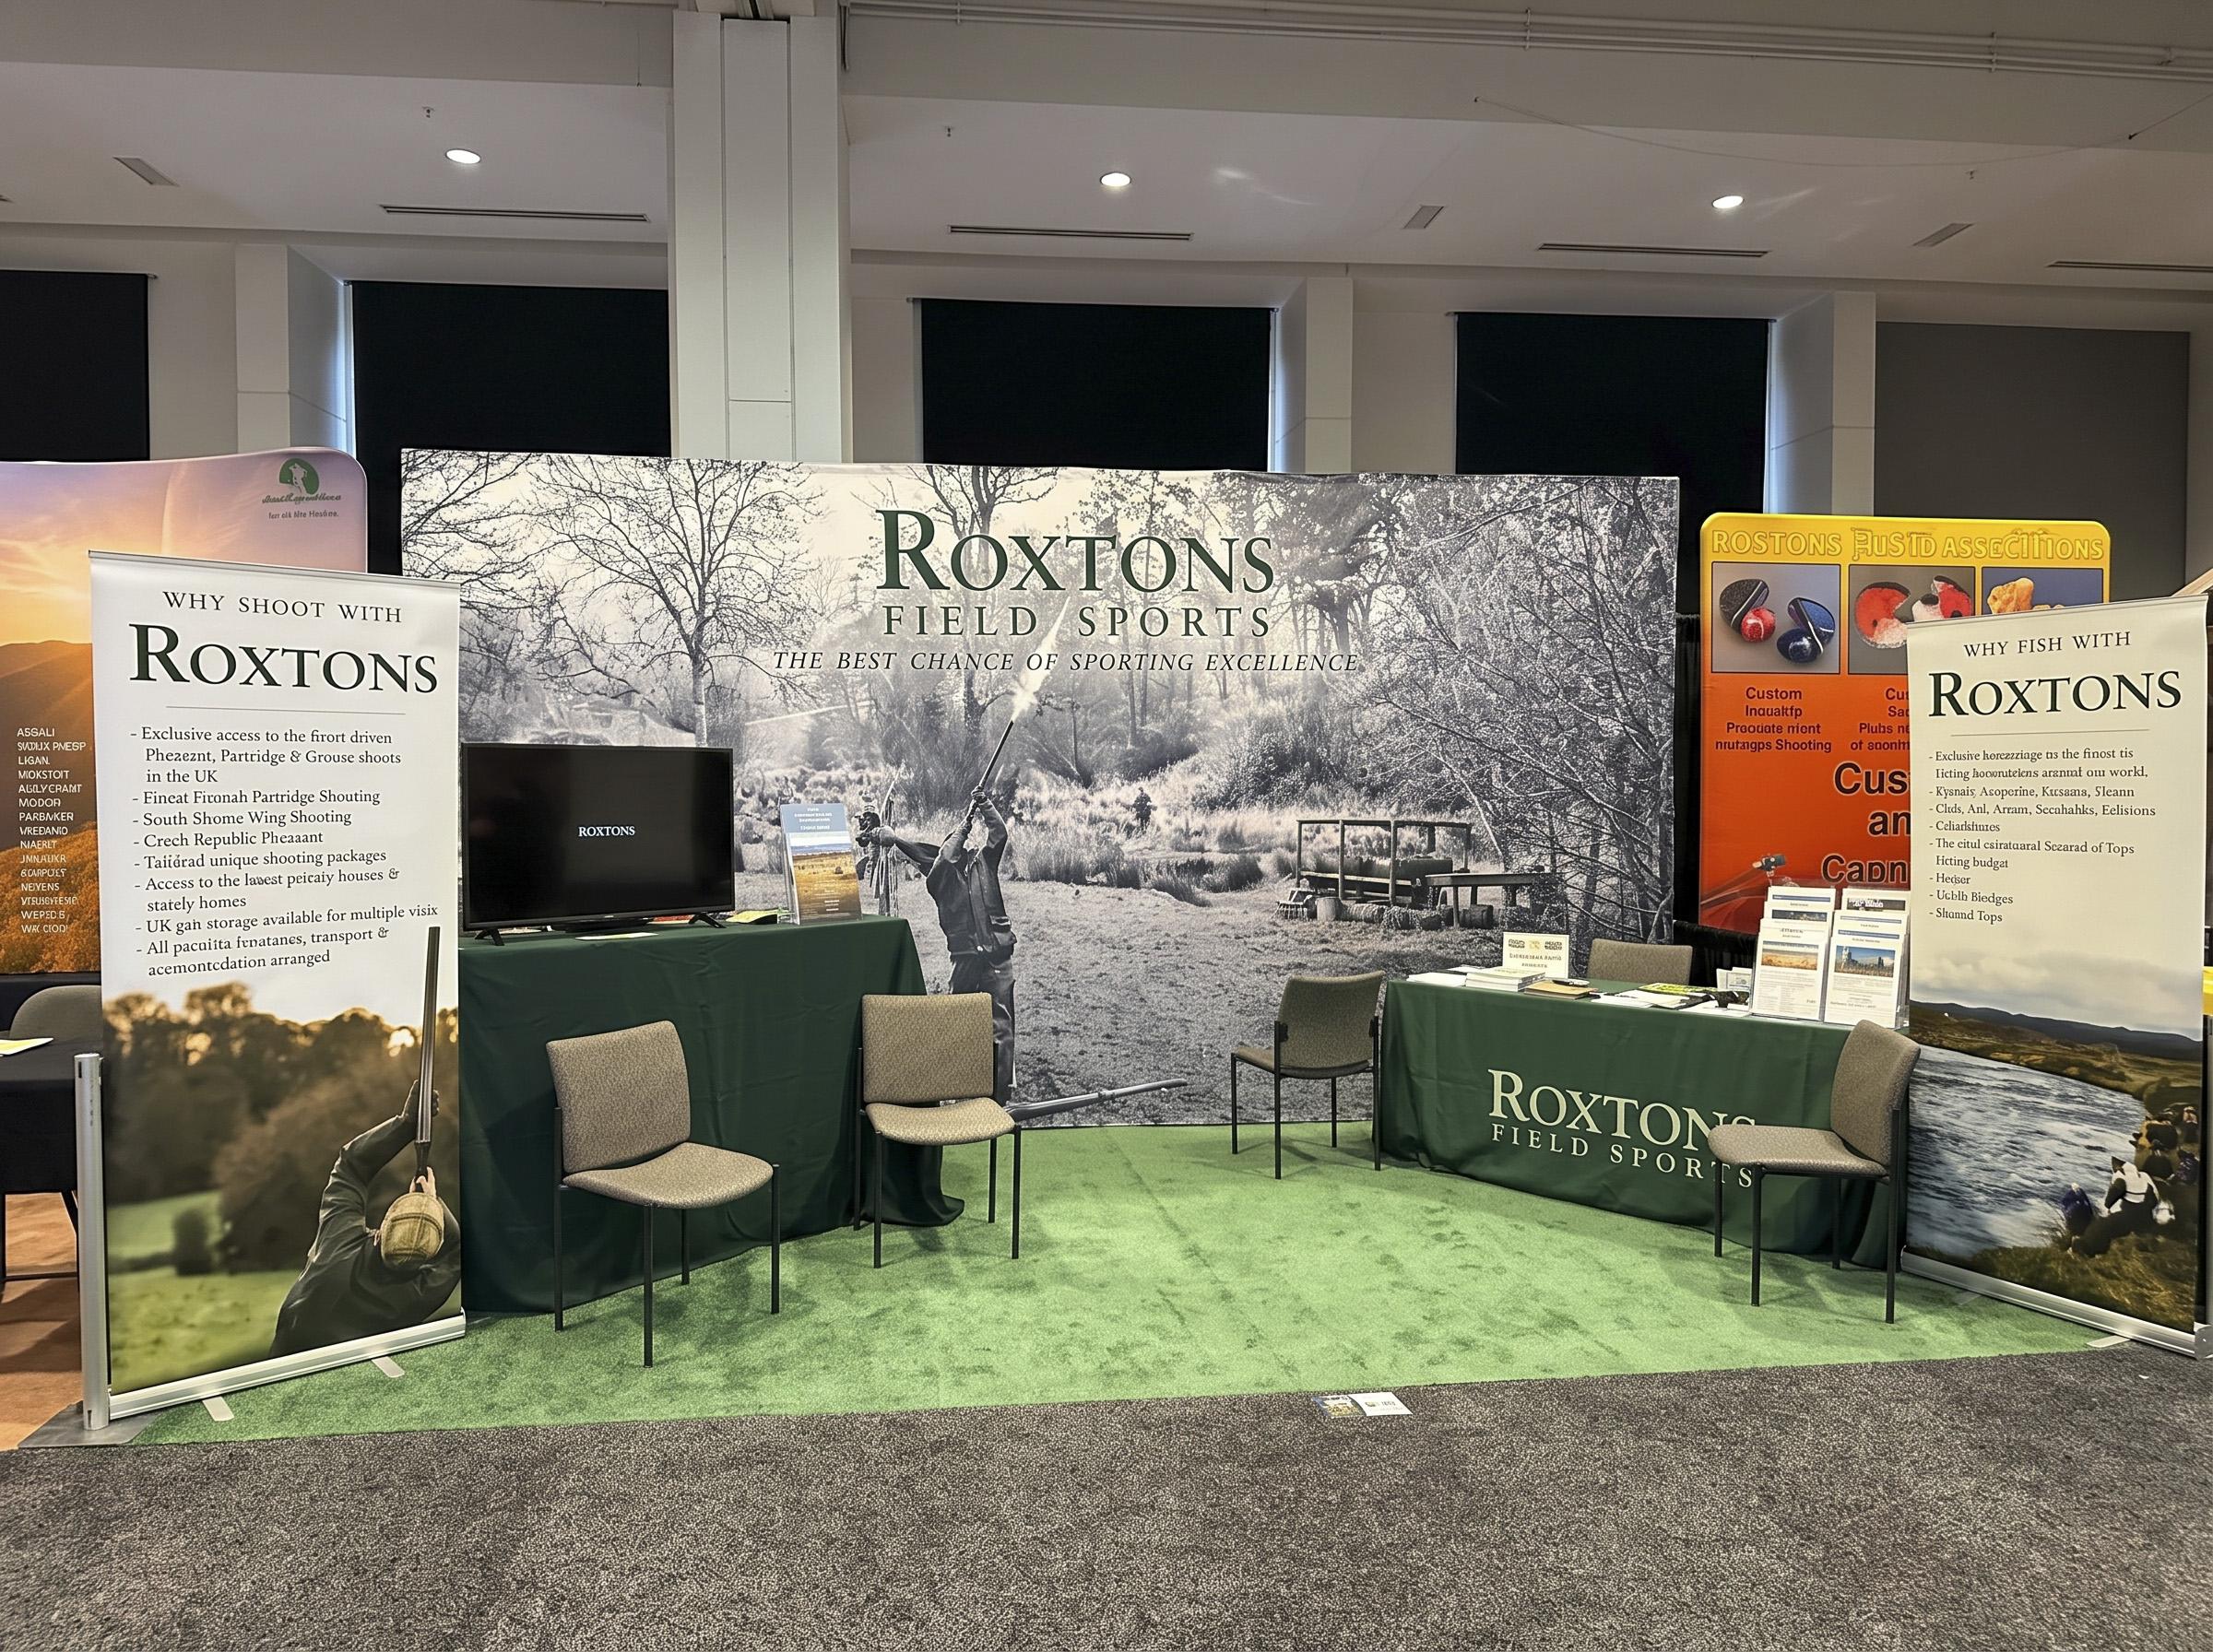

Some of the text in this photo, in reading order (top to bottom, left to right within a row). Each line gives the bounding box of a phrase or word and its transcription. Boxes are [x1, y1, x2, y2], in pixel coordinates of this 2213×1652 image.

[875, 509, 1274, 595] ROXTONS
[1712, 529, 1842, 557] ROSTONS
[161, 590, 402, 623] WHY SHOOT WITH
[882, 606, 1270, 639] FIELD SPORTS
[1964, 631, 2132, 657] WHY FISH WITH
[128, 623, 438, 693] ROXTONS
[773, 651, 1359, 673] THE BEST CHANCE OF SPORTING EXCELLENCE
[1746, 687, 1803, 700] Custom
[1928, 670, 2183, 717] ROXTONS
[141, 726, 212, 740] Exclusive
[217, 731, 261, 741] access
[266, 731, 279, 742] to
[284, 729, 306, 742] the
[350, 730, 392, 744] driven
[1775, 739, 1832, 753] Shooting
[1935, 750, 1981, 761] Exclusive
[2062, 749, 2079, 759] the
[2083, 748, 2115, 759] finost
[290, 750, 302, 762] &
[305, 750, 355, 763] Grouse
[359, 750, 401, 763] shoots
[147, 769, 219, 783] in the UK
[1833, 761, 1910, 796] Cus
[252, 790, 315, 806] Partridge
[319, 789, 381, 806] Shouting
[143, 810, 352, 827] South Shome Wing Shooting
[144, 832, 189, 847] Crech
[194, 832, 257, 849] Republic
[578, 825, 635, 837] ROXTONS
[1935, 838, 1955, 849] The
[2091, 842, 2104, 853] of
[2105, 842, 2135, 856] Tops
[209, 854, 259, 870] unique
[263, 851, 324, 867] shooting
[326, 849, 386, 867] packages
[145, 878, 195, 891] Access
[199, 878, 213, 888] to
[218, 874, 240, 887] the
[337, 868, 384, 882] houses
[388, 867, 400, 879] &
[147, 896, 246, 914] stately homes
[147, 919, 172, 933] UK
[207, 916, 258, 932] storage
[263, 910, 323, 926] available
[326, 909, 347, 922] for
[350, 905, 405, 923] multiple
[1977, 910, 2003, 925] Tops
[147, 940, 169, 954] All
[311, 928, 373, 945] transport
[377, 926, 389, 938] &
[270, 950, 330, 967] arranged
[1492, 1123, 1753, 1188] FIELD SPORTS
